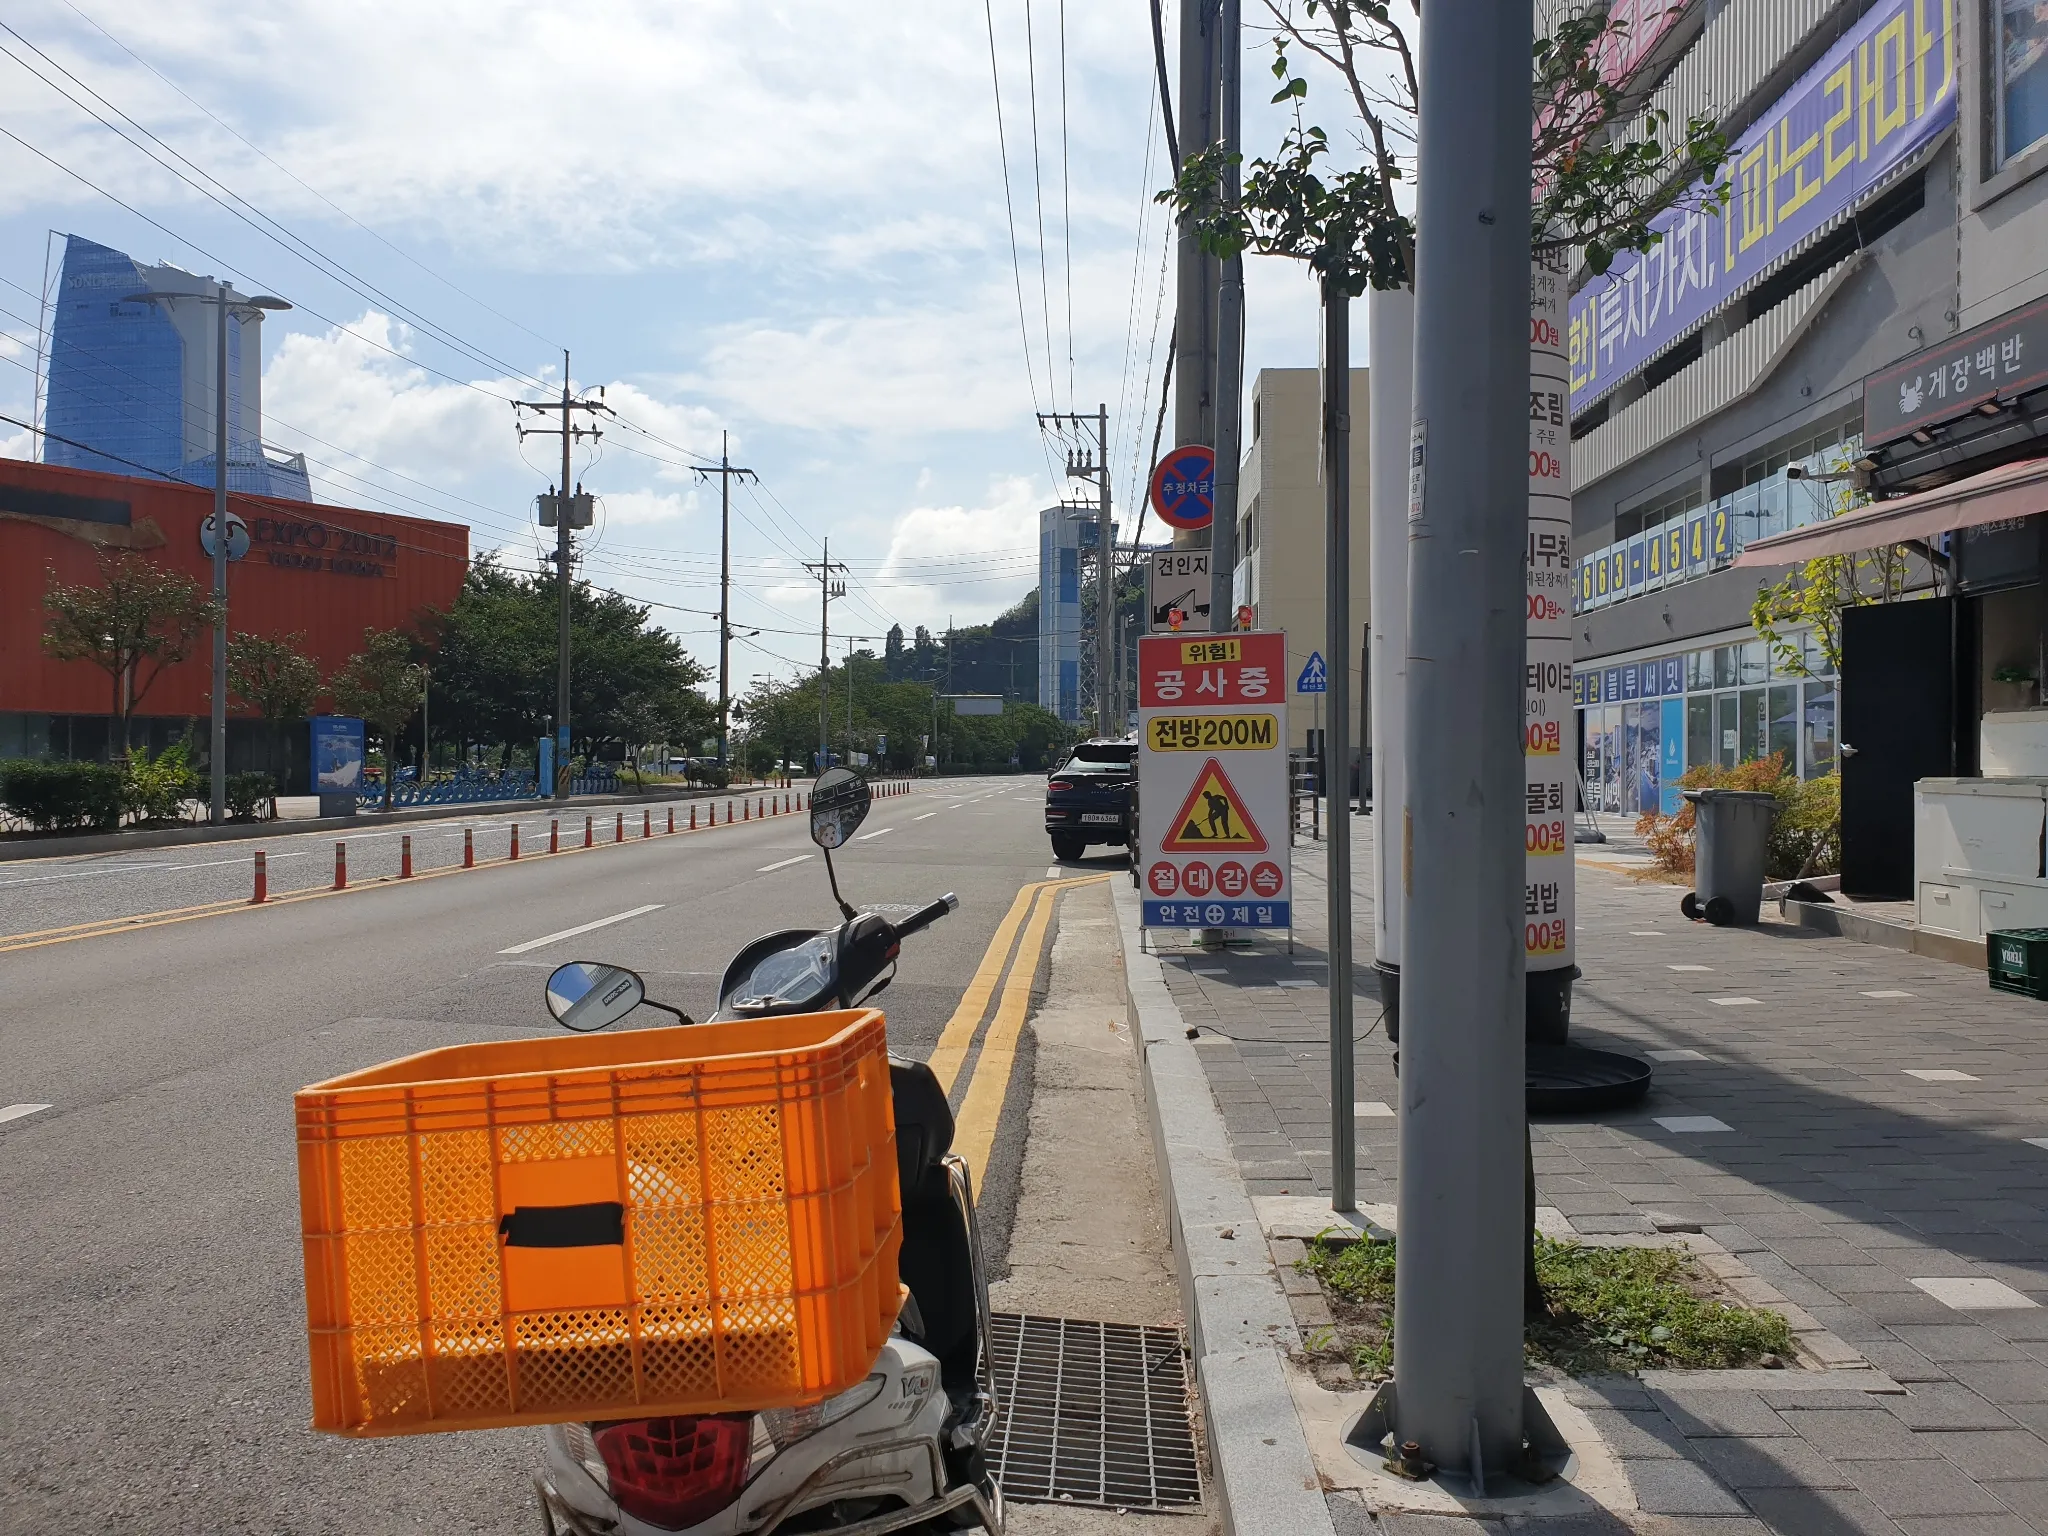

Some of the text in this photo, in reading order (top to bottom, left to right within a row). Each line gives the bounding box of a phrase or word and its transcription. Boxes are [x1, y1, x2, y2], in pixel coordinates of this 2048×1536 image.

[1536, 429, 1557, 445] 주문
[1163, 481, 1214, 495] 주정차금
[1583, 511, 1726, 599] 663-4542
[1188, 642, 1235, 662] 위험!
[1527, 781, 1564, 814] 물회
